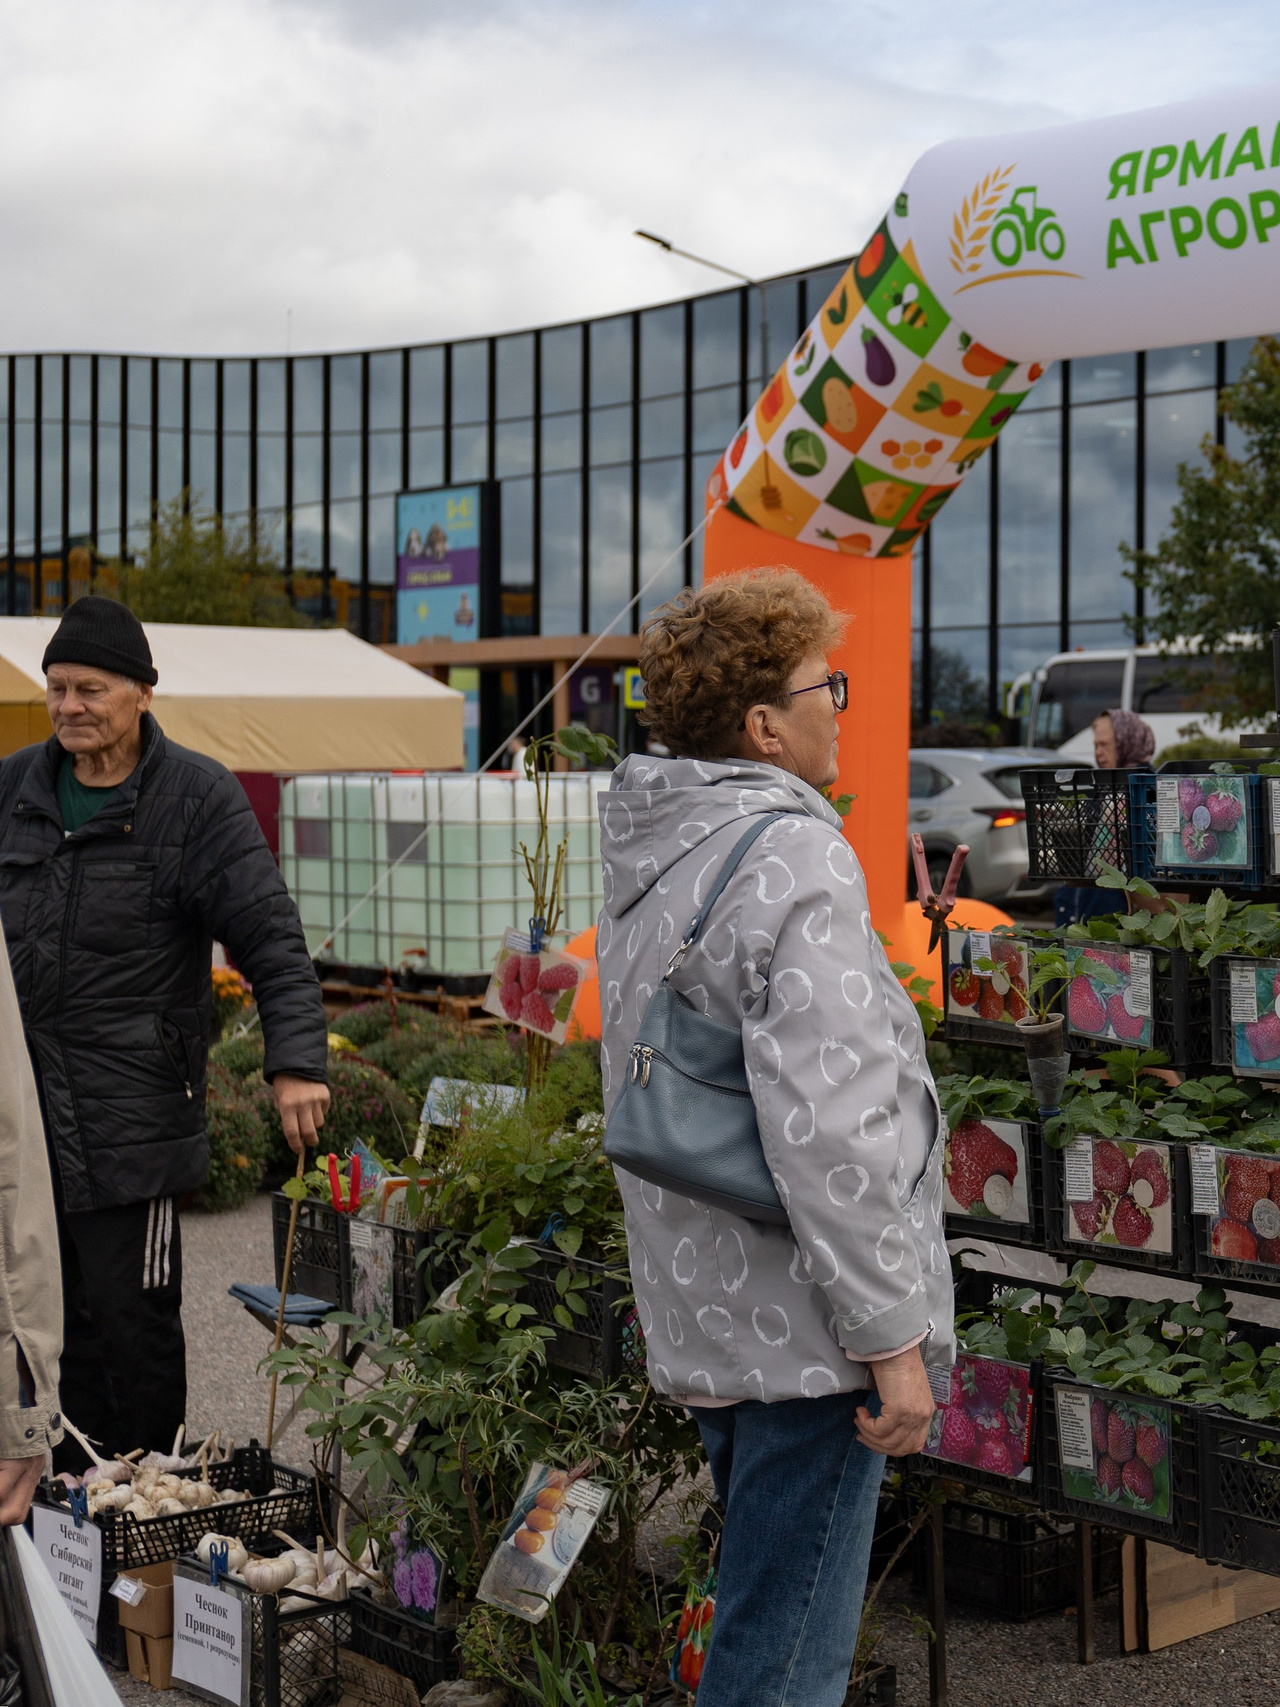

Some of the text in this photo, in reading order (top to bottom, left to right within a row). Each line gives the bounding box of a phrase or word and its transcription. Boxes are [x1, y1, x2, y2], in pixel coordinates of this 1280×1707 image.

[580, 675, 600, 704] G
[59, 1523, 89, 1547] Чеснок
[50, 1543, 93, 1573] Сибирский
[58, 1571, 84, 1591] гигант
[195, 1592, 228, 1620] Чеснок
[185, 1612, 236, 1650] Принтанор
